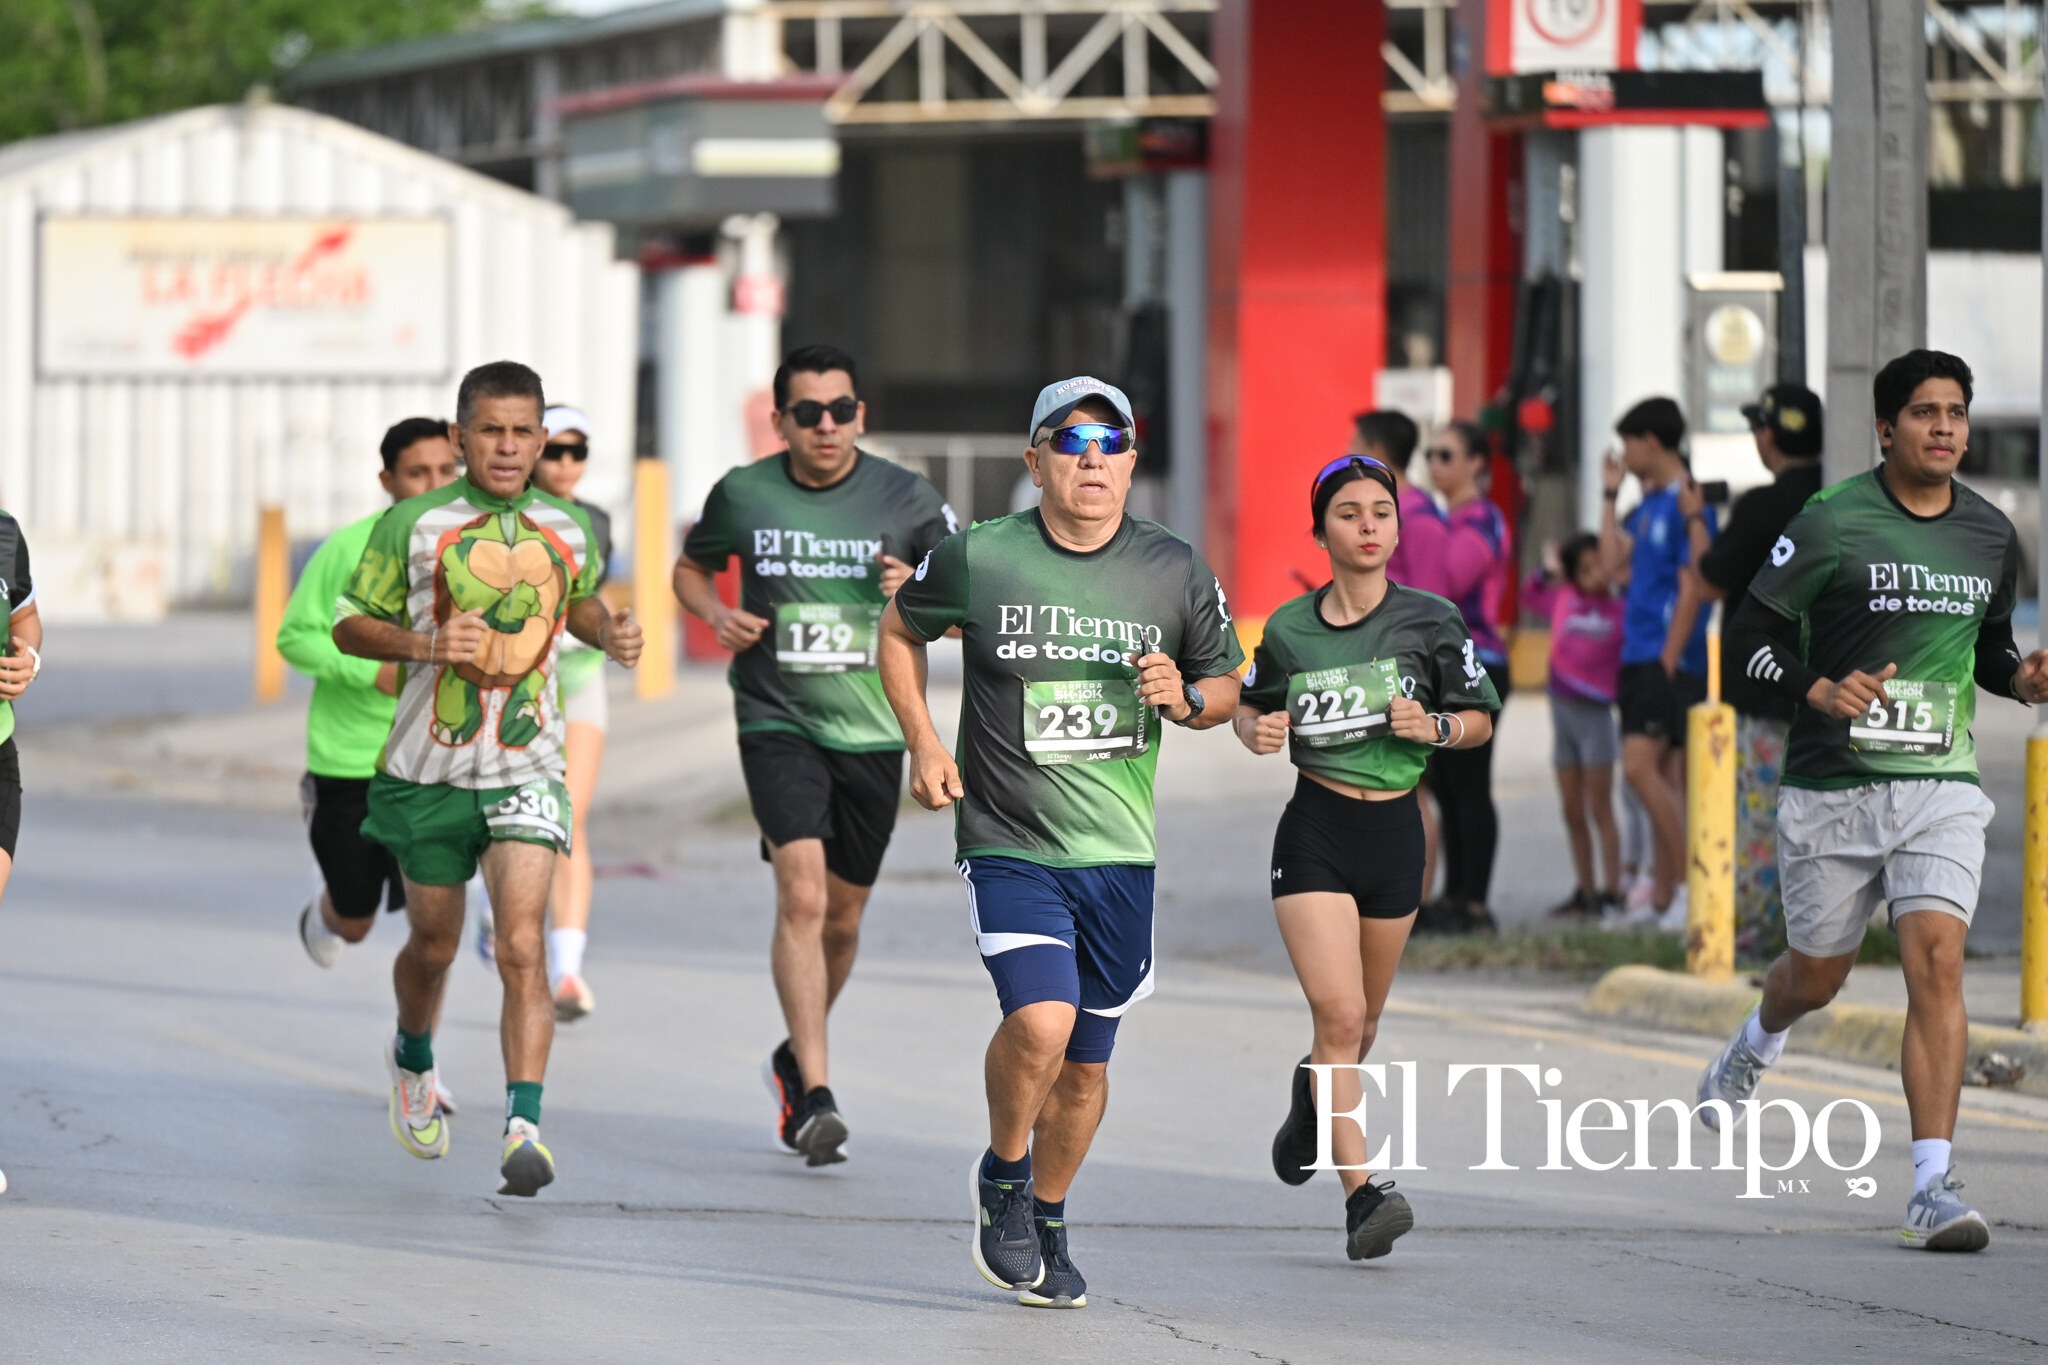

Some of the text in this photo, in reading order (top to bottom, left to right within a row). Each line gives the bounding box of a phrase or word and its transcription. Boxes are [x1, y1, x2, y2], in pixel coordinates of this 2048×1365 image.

[754, 529, 882, 563] El Tiemp
[755, 559, 868, 579] de todos
[1866, 563, 1992, 601] El Tiempo
[1869, 595, 1976, 616] de todos
[788, 623, 853, 652] 129
[997, 604, 1162, 651] El Tiempo
[996, 641, 1038, 660] de
[1305, 667, 1348, 680] CARRERA
[1039, 703, 1118, 739] 239
[1297, 685, 1369, 725] 222
[1945, 699, 1956, 747] MEDALLA
